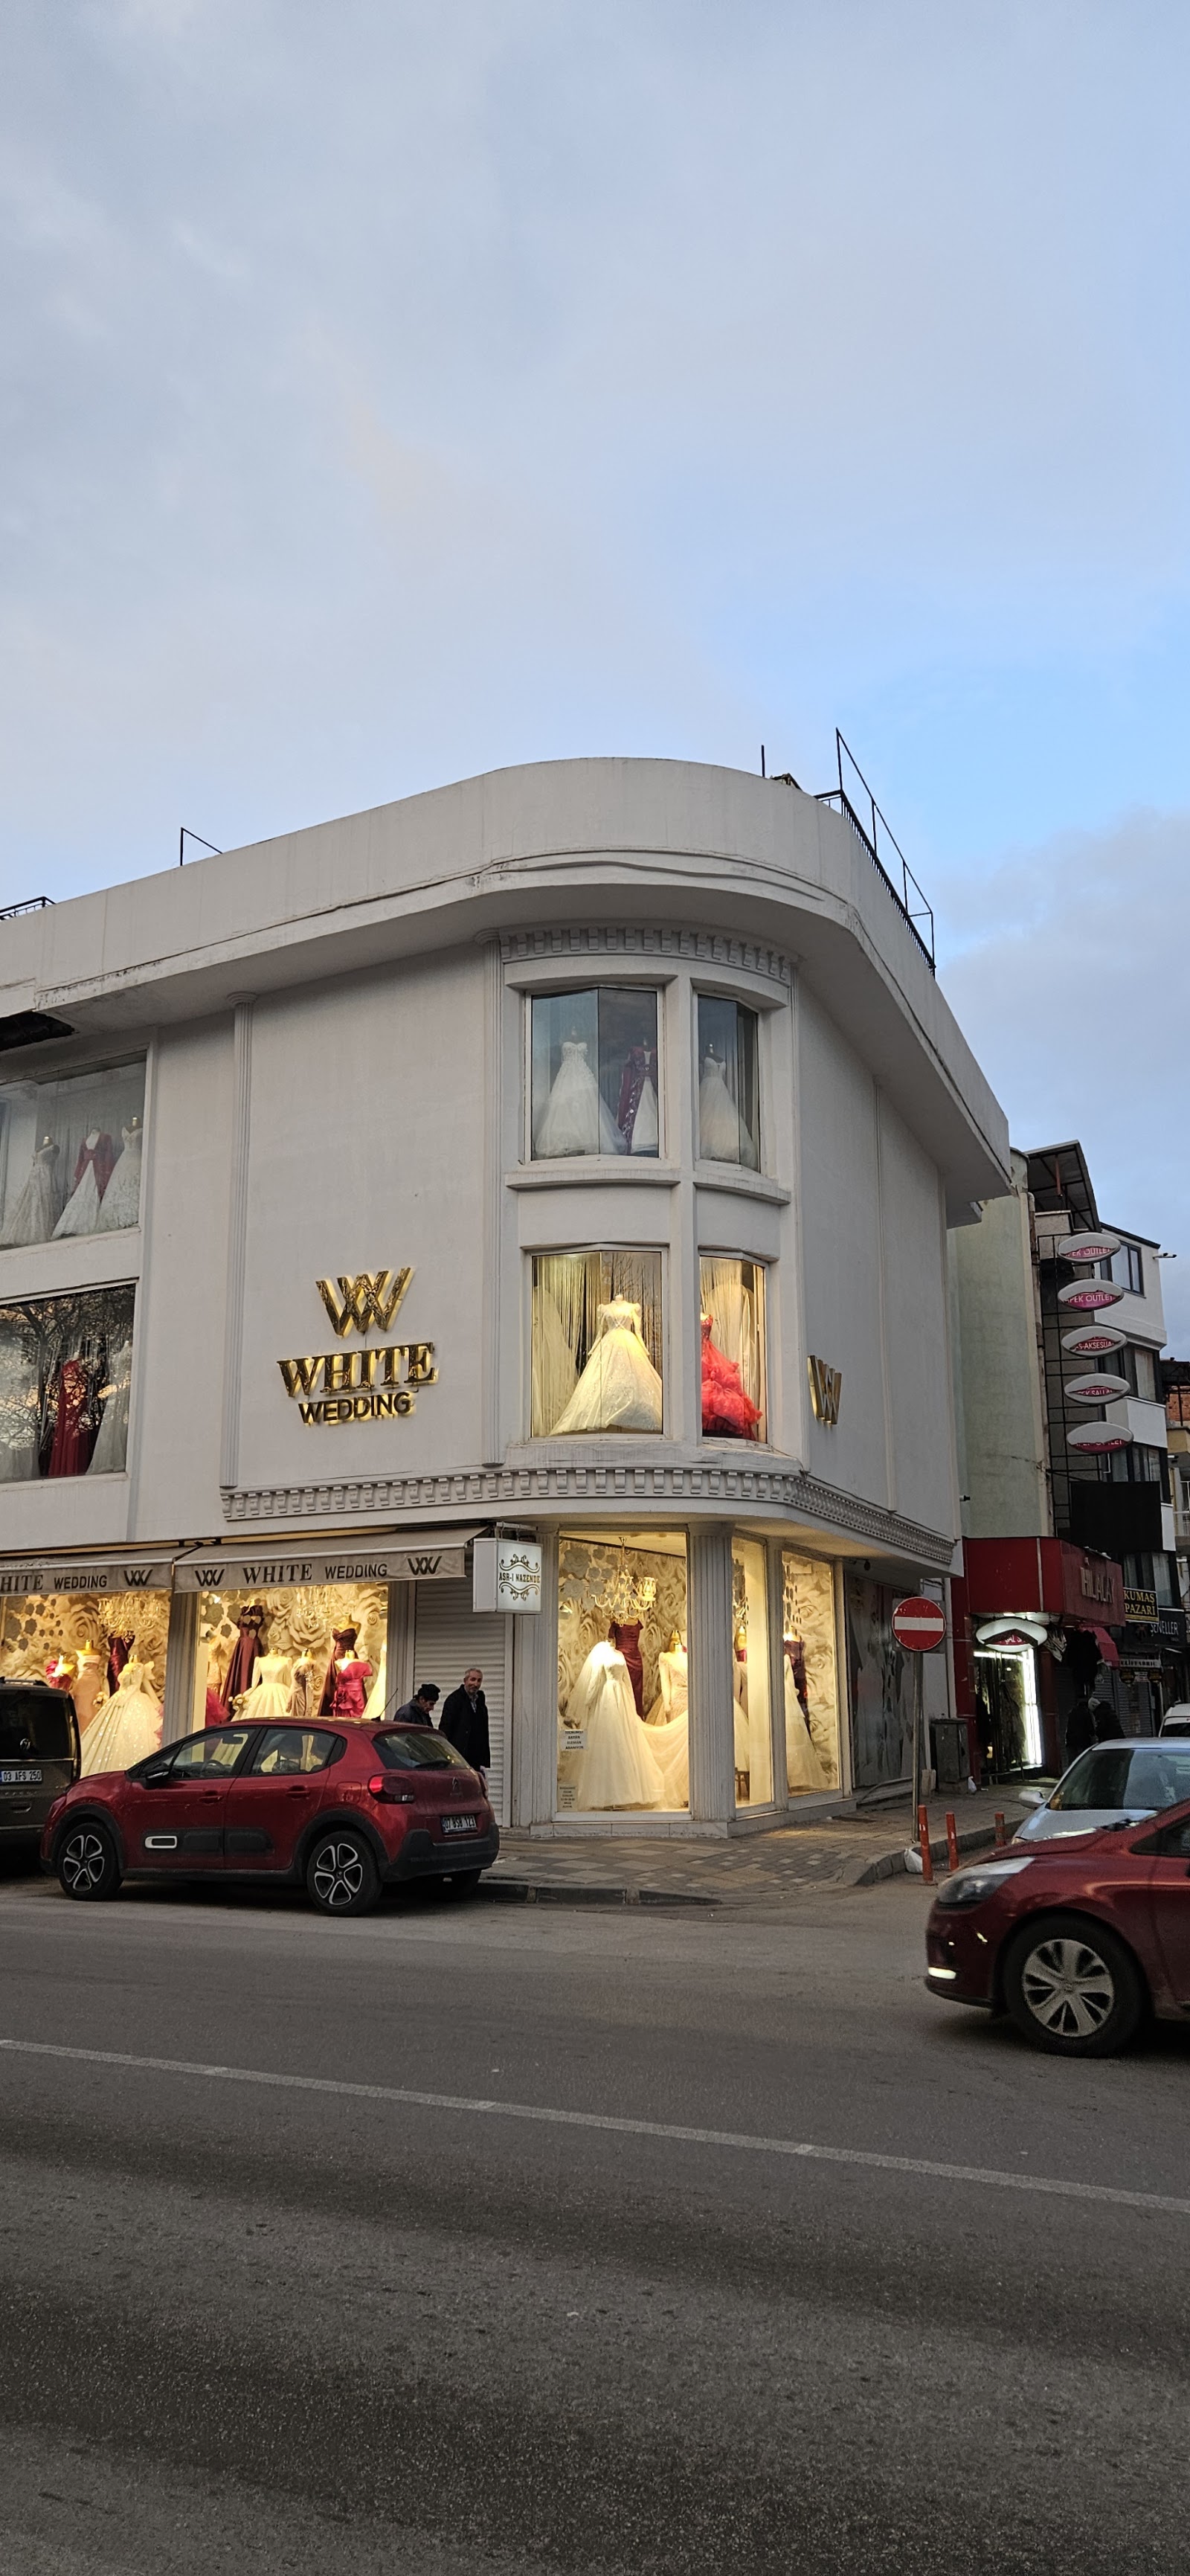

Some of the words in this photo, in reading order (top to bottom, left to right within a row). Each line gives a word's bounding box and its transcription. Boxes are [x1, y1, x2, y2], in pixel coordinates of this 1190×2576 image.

[277, 1342, 437, 1397] WHITE
[298, 1392, 412, 1424] WEDDING
[0, 1574, 43, 1592] HITE
[54, 1575, 107, 1590] WEDDING
[242, 1564, 312, 1584] WHITE
[325, 1563, 387, 1579] WEDDING
[515, 1573, 541, 1584] NAZENDE
[1124, 1590, 1155, 1605] KUMAŞ
